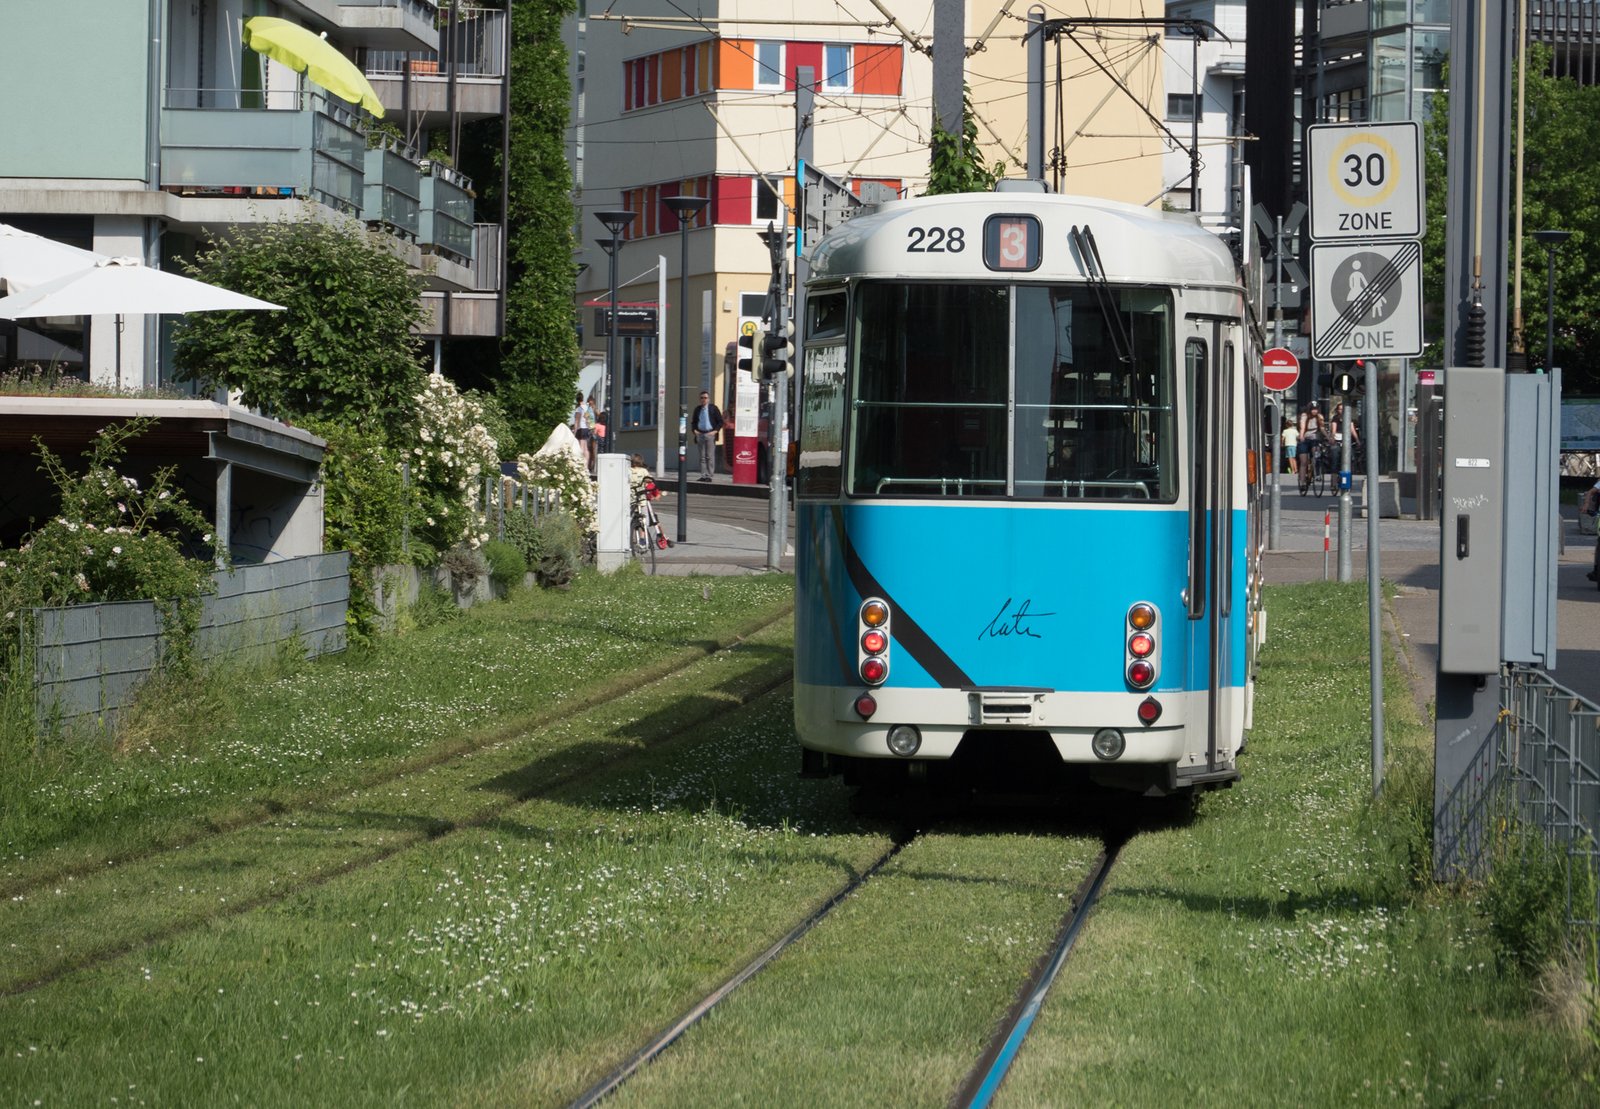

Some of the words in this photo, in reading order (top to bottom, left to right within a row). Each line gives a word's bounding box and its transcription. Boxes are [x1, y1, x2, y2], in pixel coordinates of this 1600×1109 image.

[1344, 153, 1385, 187] 30
[1339, 212, 1392, 231] ZONE
[907, 227, 965, 253] 228
[1001, 226, 1026, 262] 3
[1341, 331, 1395, 350] ZONE
